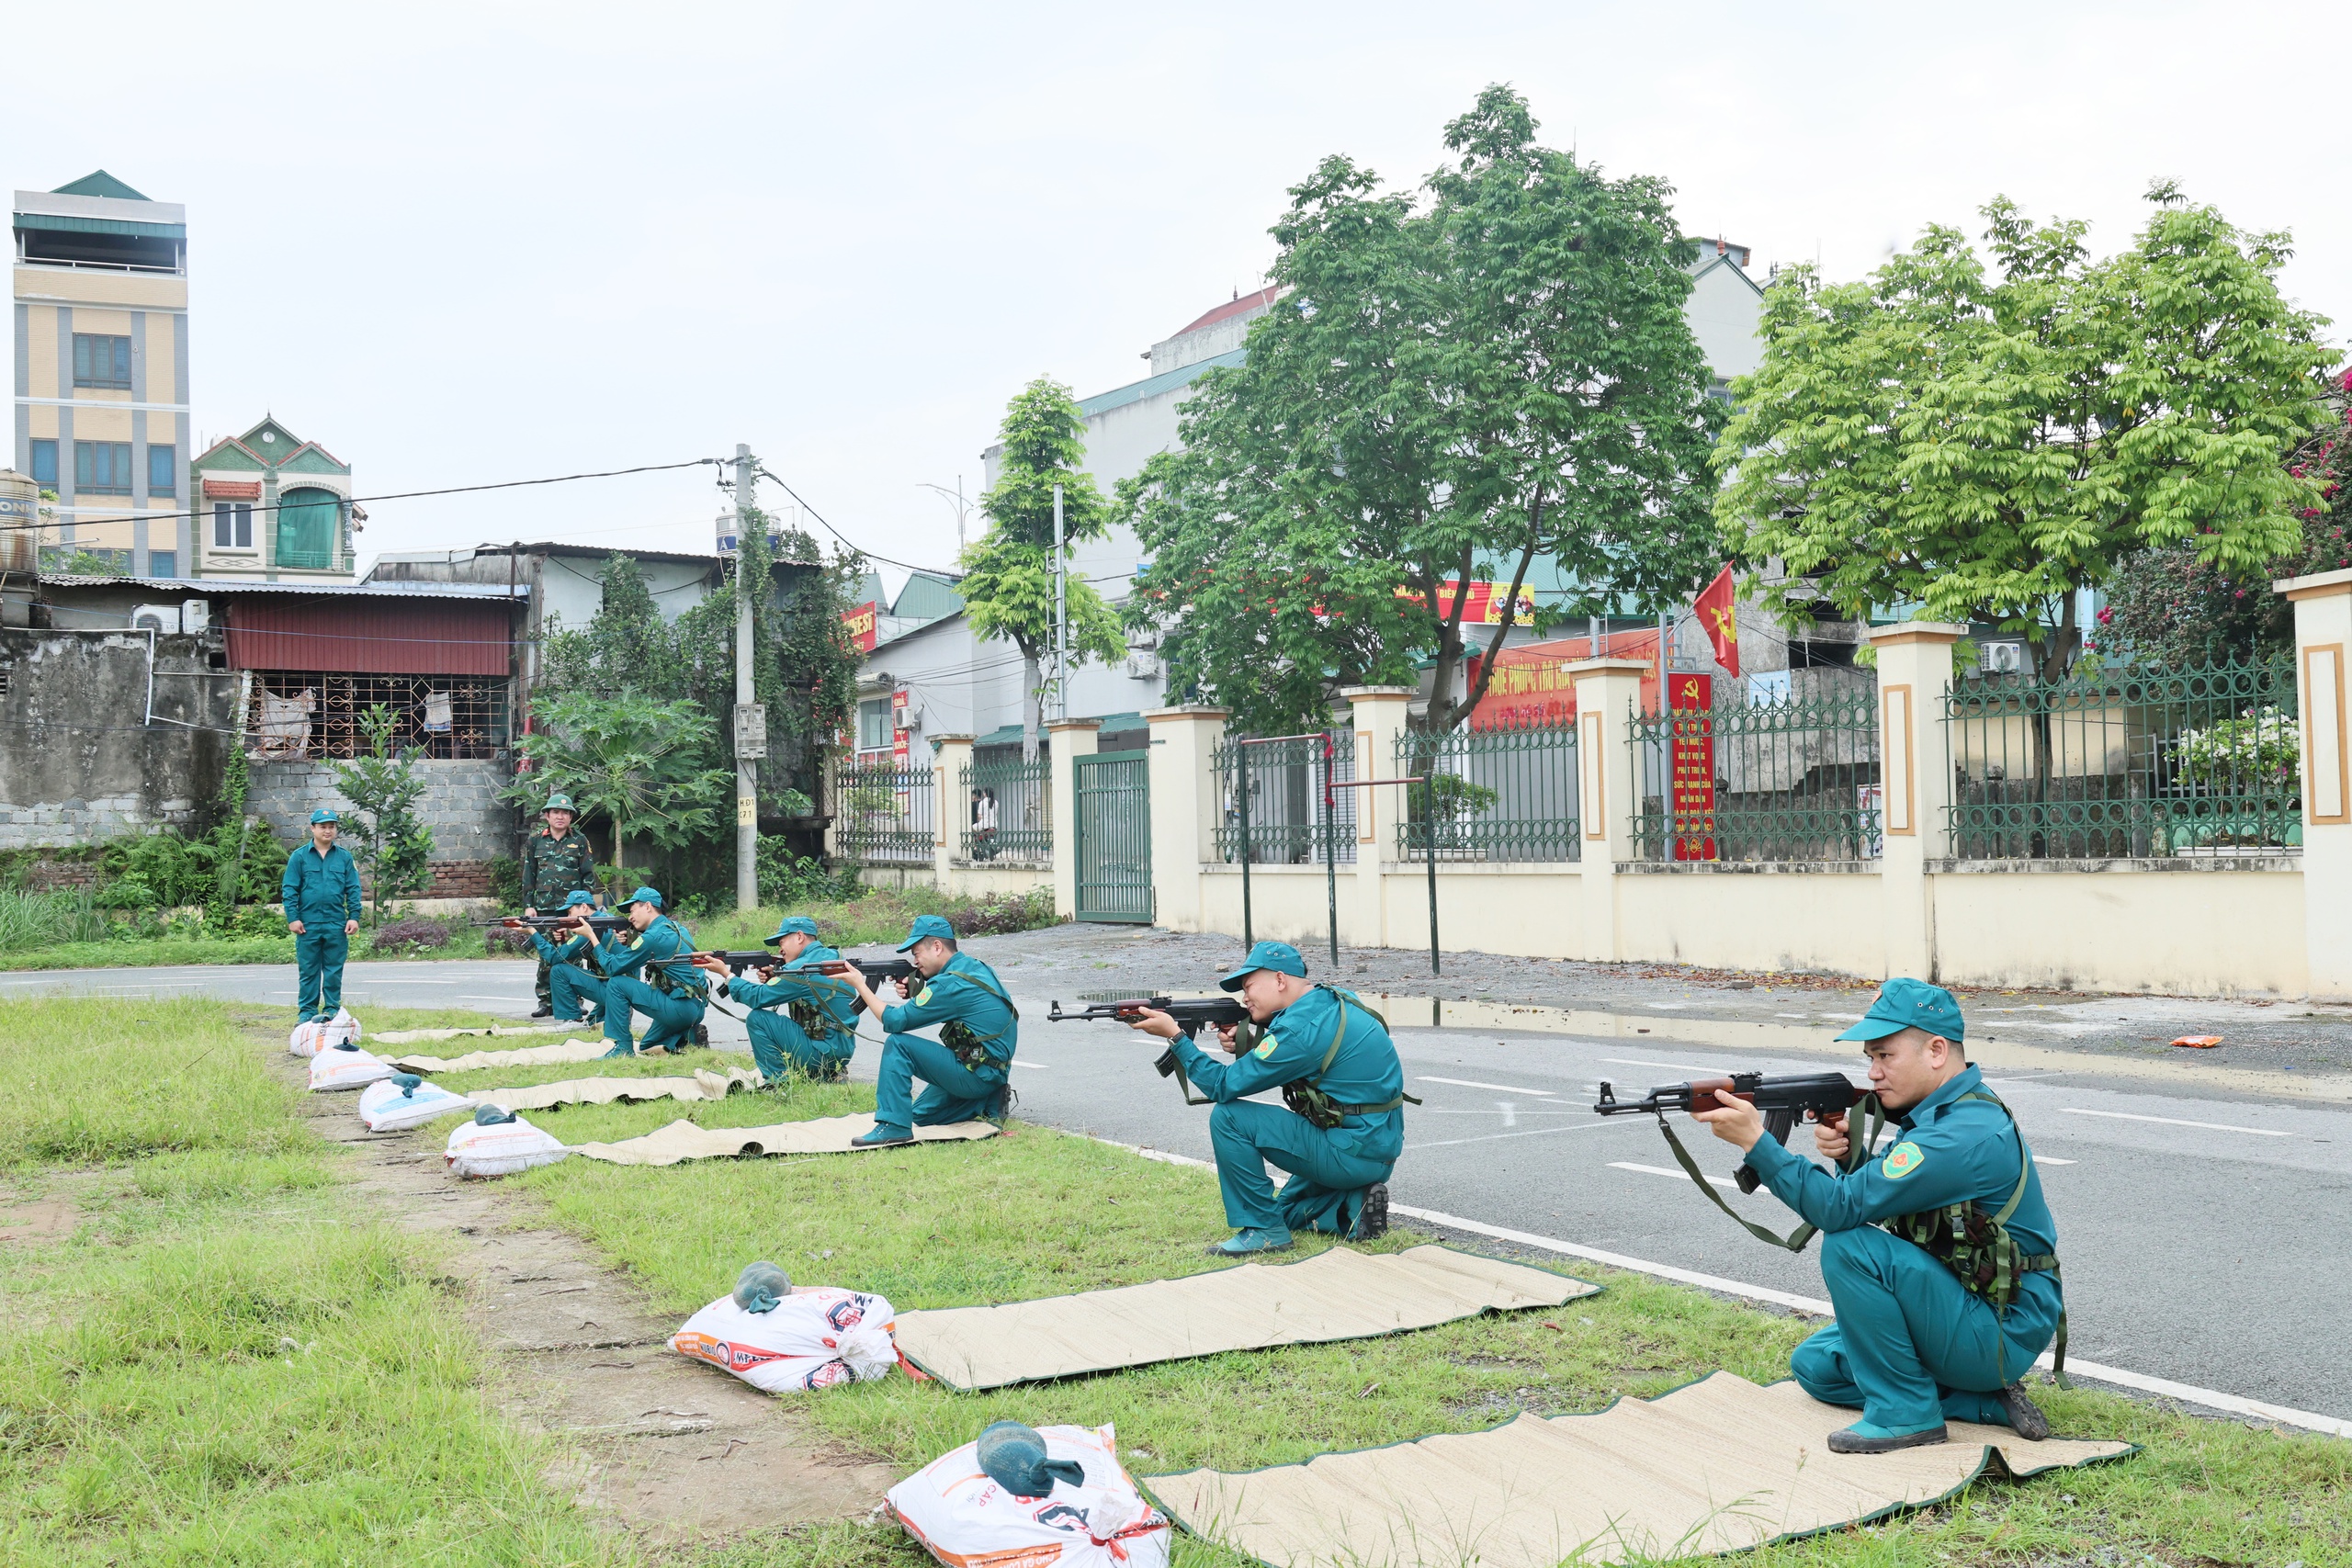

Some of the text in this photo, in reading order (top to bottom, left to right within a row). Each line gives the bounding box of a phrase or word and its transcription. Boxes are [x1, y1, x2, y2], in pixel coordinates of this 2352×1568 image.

[1678, 751, 1691, 760] KHT
[1677, 766, 1708, 775] PHT TRIN,
